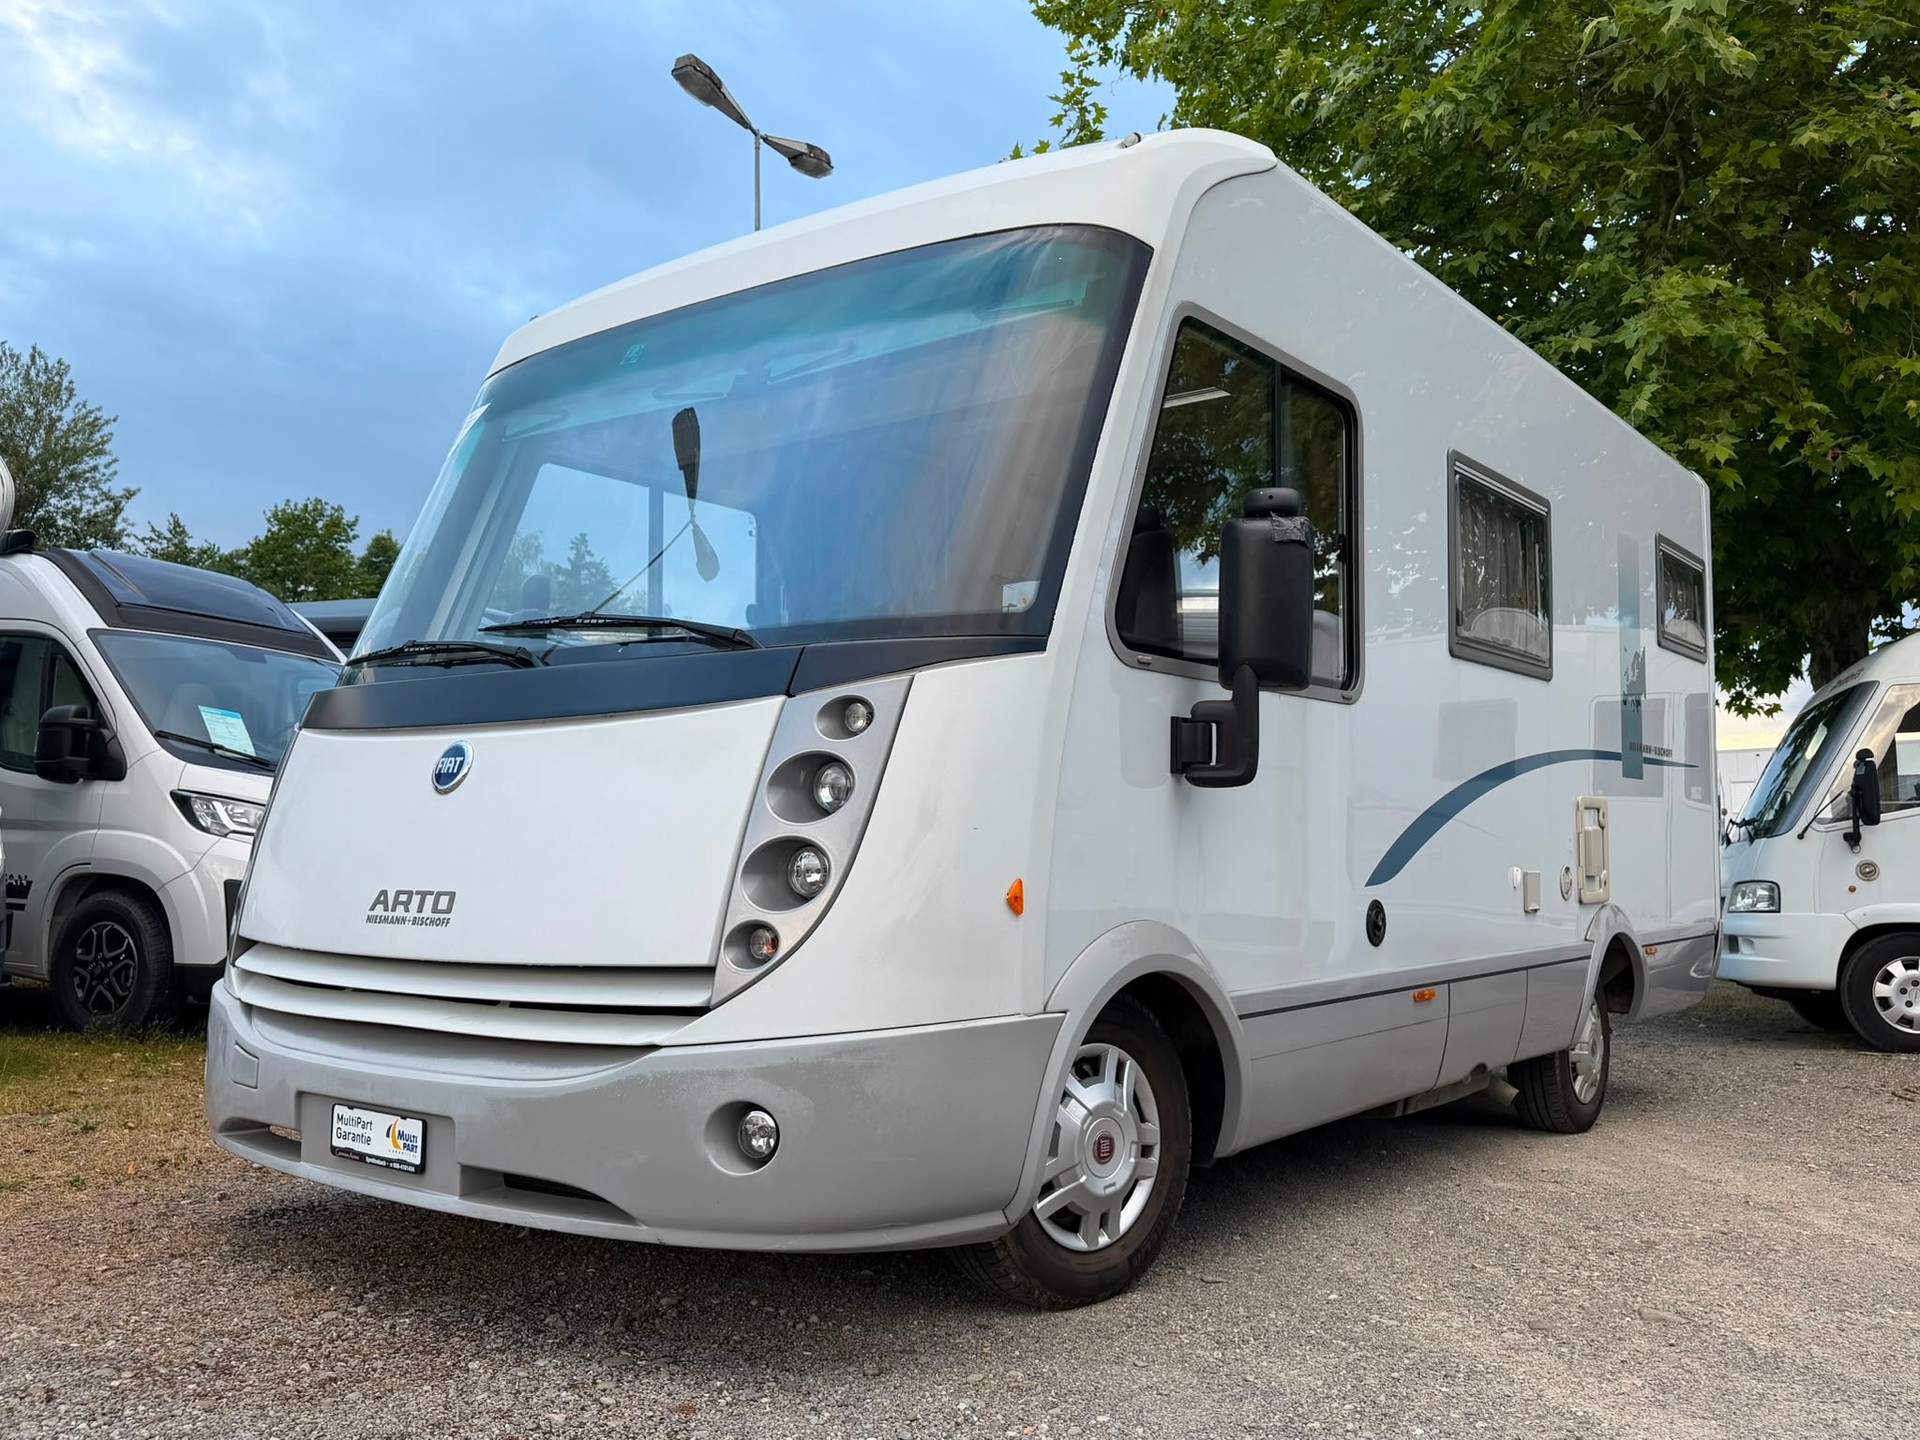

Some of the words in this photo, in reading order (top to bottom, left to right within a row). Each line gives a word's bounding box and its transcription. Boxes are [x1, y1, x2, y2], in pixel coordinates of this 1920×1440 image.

[435, 756, 464, 774] FIAT
[5, 873, 28, 886] AN
[369, 889, 456, 914] ARTO
[366, 914, 451, 928] NIESMANN+BISCHOFF
[336, 1113, 373, 1131] MultiPart
[335, 1127, 372, 1146] Garantie
[397, 1130, 418, 1144] MULTI
[402, 1142, 418, 1154] PART
[1100, 1138, 1111, 1157] FIAT
